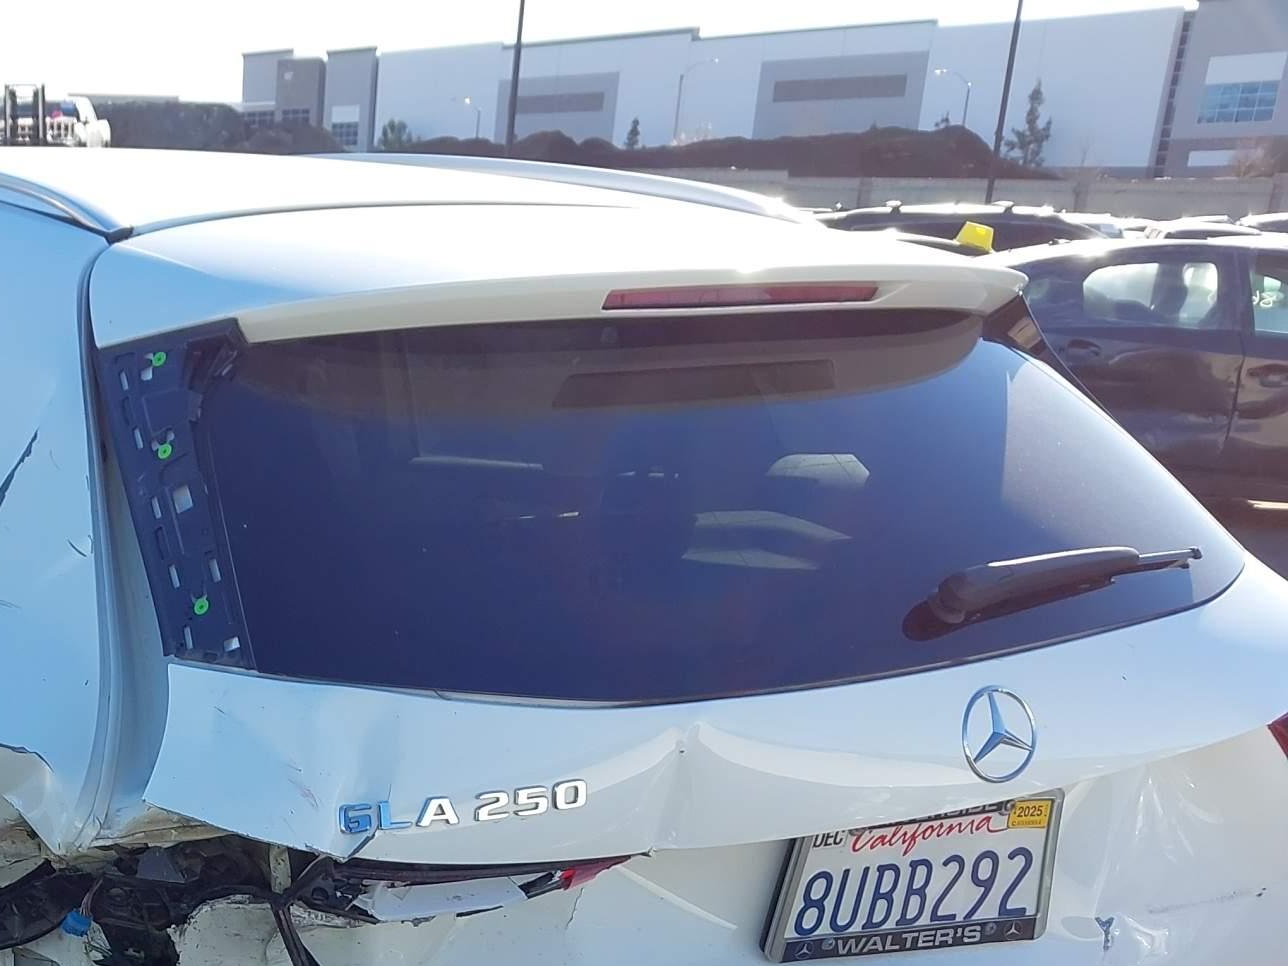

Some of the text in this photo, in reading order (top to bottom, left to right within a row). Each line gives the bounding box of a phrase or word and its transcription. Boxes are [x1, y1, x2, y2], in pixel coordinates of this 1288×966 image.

[339, 779, 588, 833] GLA 250
[1016, 805, 1043, 818] 2025
[812, 830, 845, 849] DEC
[851, 814, 1009, 856] California
[794, 847, 1033, 937] 8UBB292
[836, 925, 982, 955] WALTER'S
